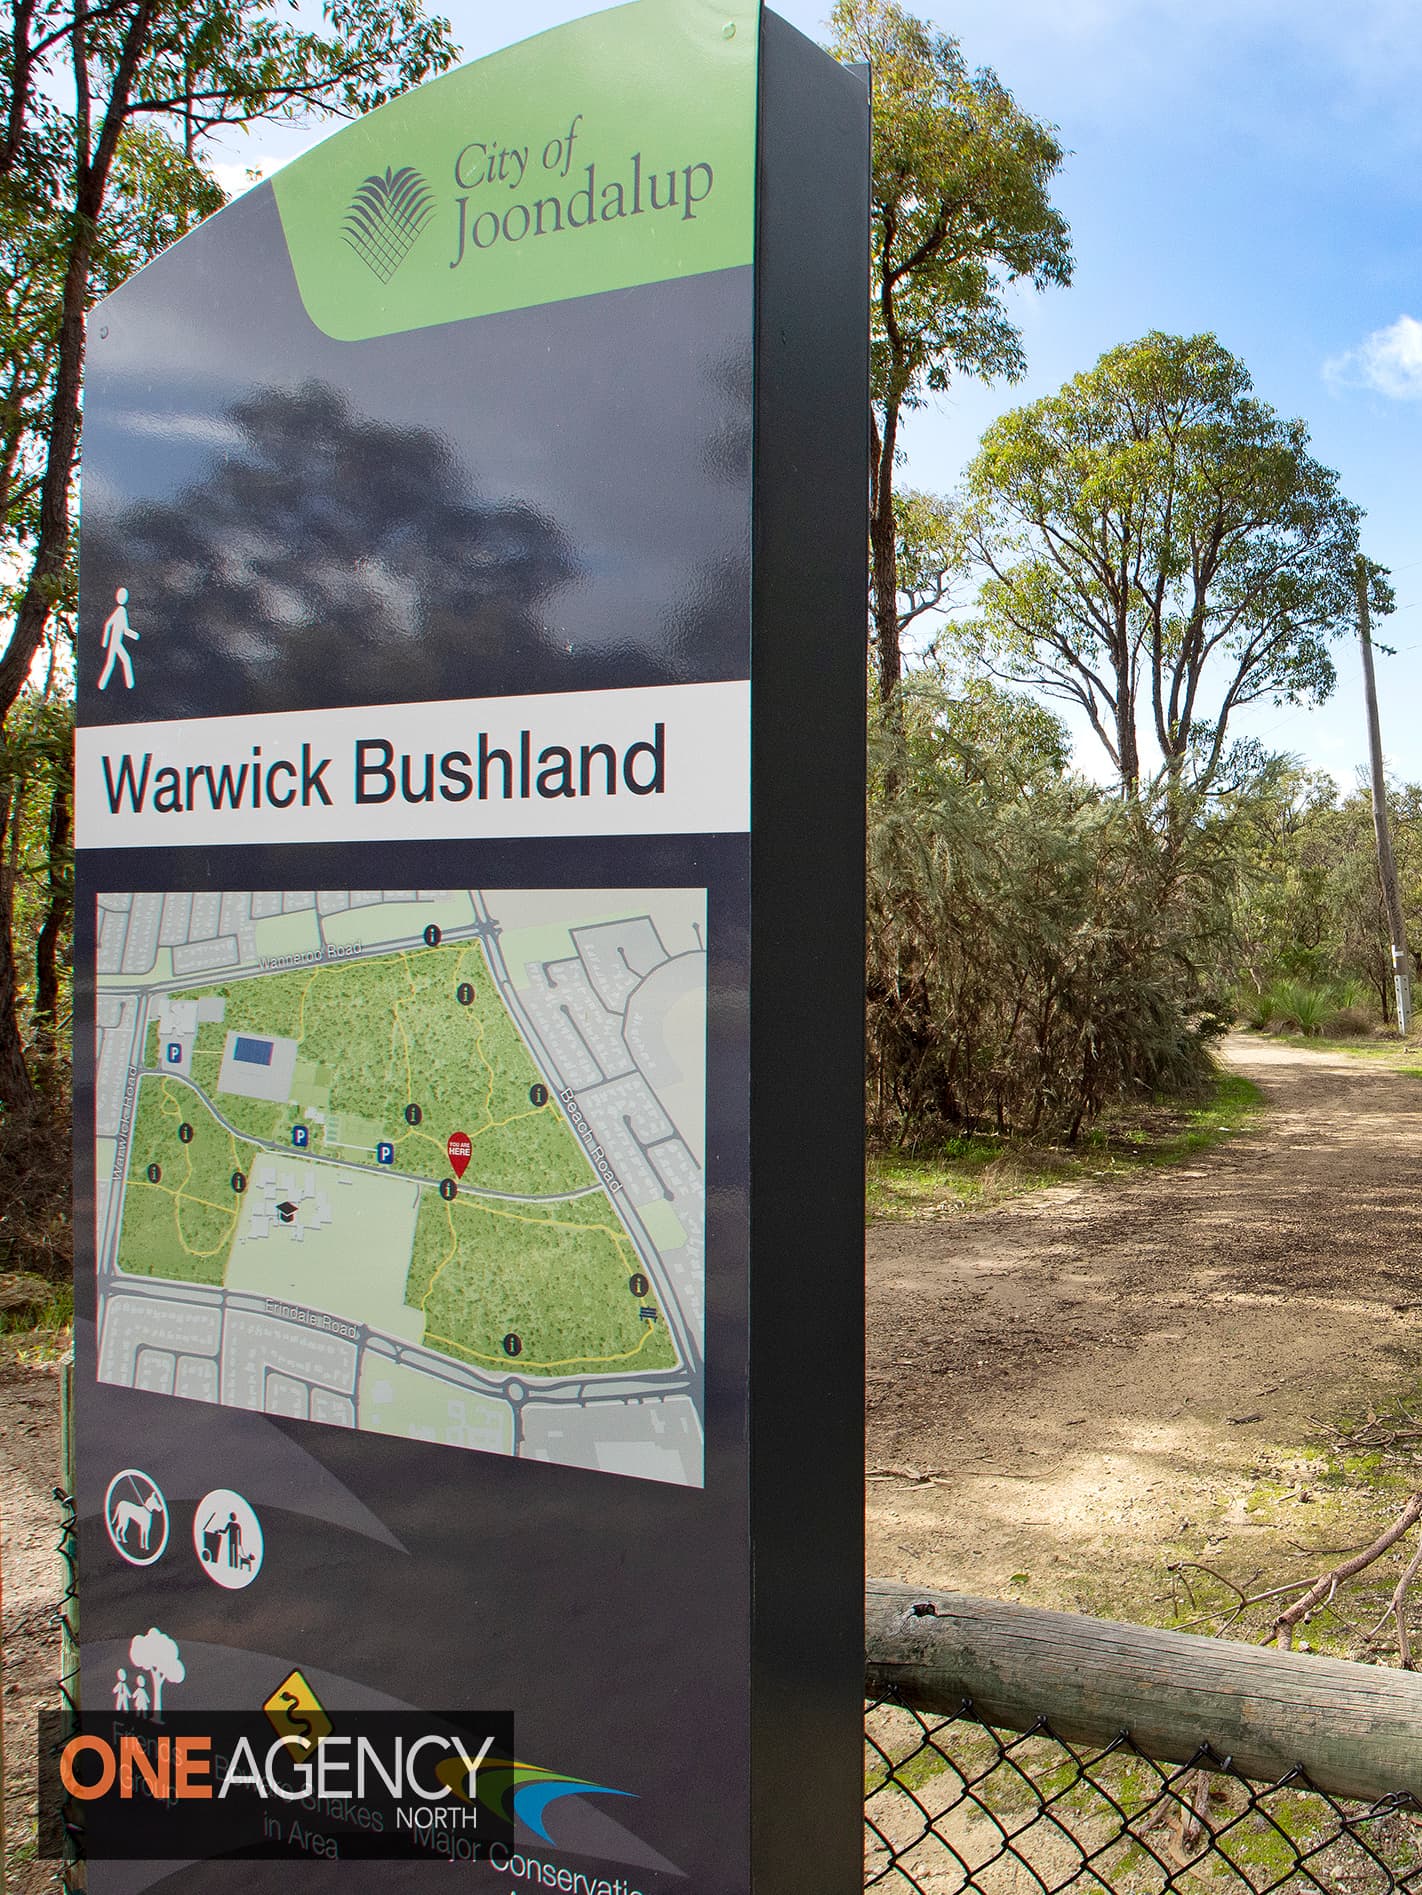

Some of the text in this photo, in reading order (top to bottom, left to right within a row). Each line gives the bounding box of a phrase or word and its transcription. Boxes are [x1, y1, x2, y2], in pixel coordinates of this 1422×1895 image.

[454, 114, 583, 190] City of
[449, 152, 714, 269] Joondalup
[101, 722, 667, 815] Warwick Bushland
[327, 939, 363, 958] Road
[449, 1147, 471, 1156] HERE
[560, 1087, 624, 1193] Beach Road
[265, 1299, 358, 1339] Erindale Road
[263, 1810, 339, 1860] in Area
[413, 1823, 481, 1862] Major
